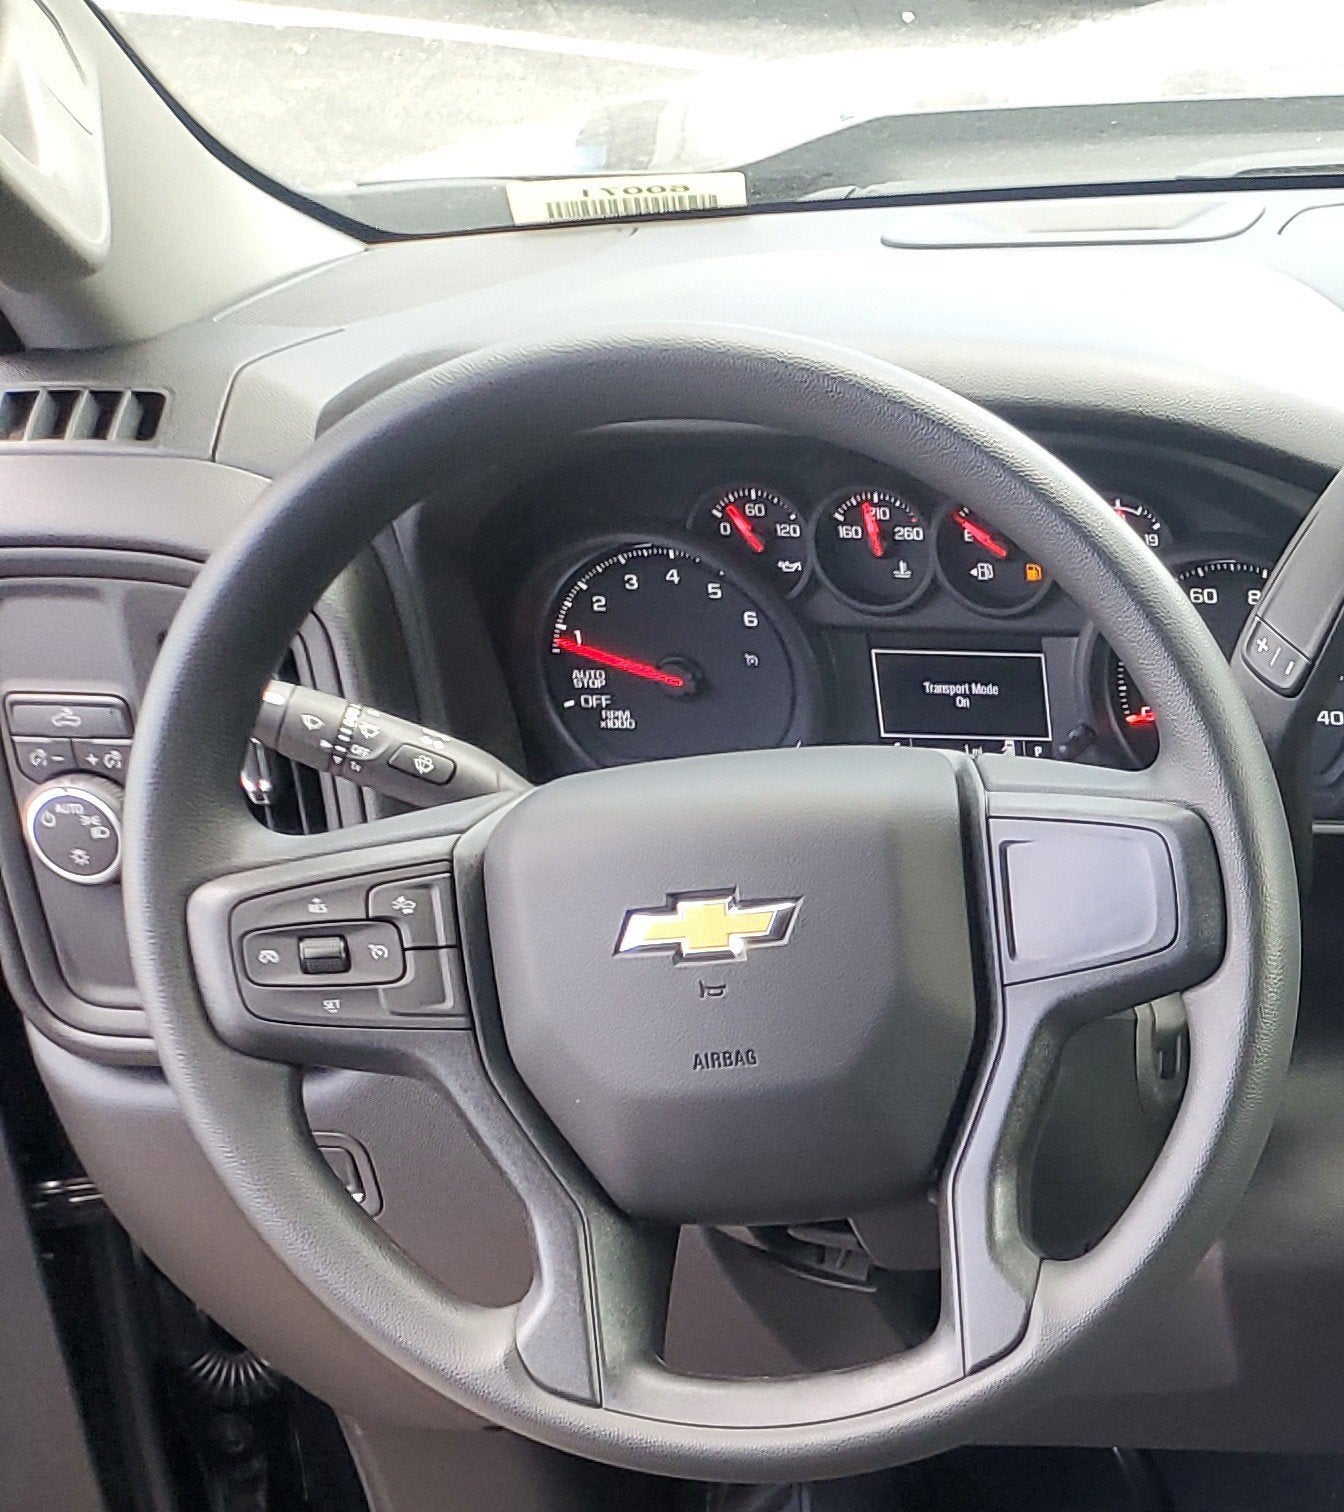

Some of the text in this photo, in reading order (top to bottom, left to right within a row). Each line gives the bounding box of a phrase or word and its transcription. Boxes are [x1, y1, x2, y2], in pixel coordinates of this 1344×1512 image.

[744, 502, 766, 517] 60
[719, 521, 732, 536] 0
[775, 523, 801, 537] 120
[837, 525, 862, 539] 160
[893, 526, 924, 541] 260
[623, 573, 639, 590] 3
[665, 568, 681, 585] 4
[706, 582, 723, 600] 5
[1189, 587, 1218, 604] 60
[591, 594, 607, 613] 2
[743, 610, 759, 628] 6
[572, 669, 606, 680] AUTO
[923, 681, 999, 696] Transport Mode
[580, 694, 612, 709] OFF
[955, 696, 970, 708] On
[601, 709, 631, 720] RPM
[692, 1048, 757, 1071] AIRBAG
